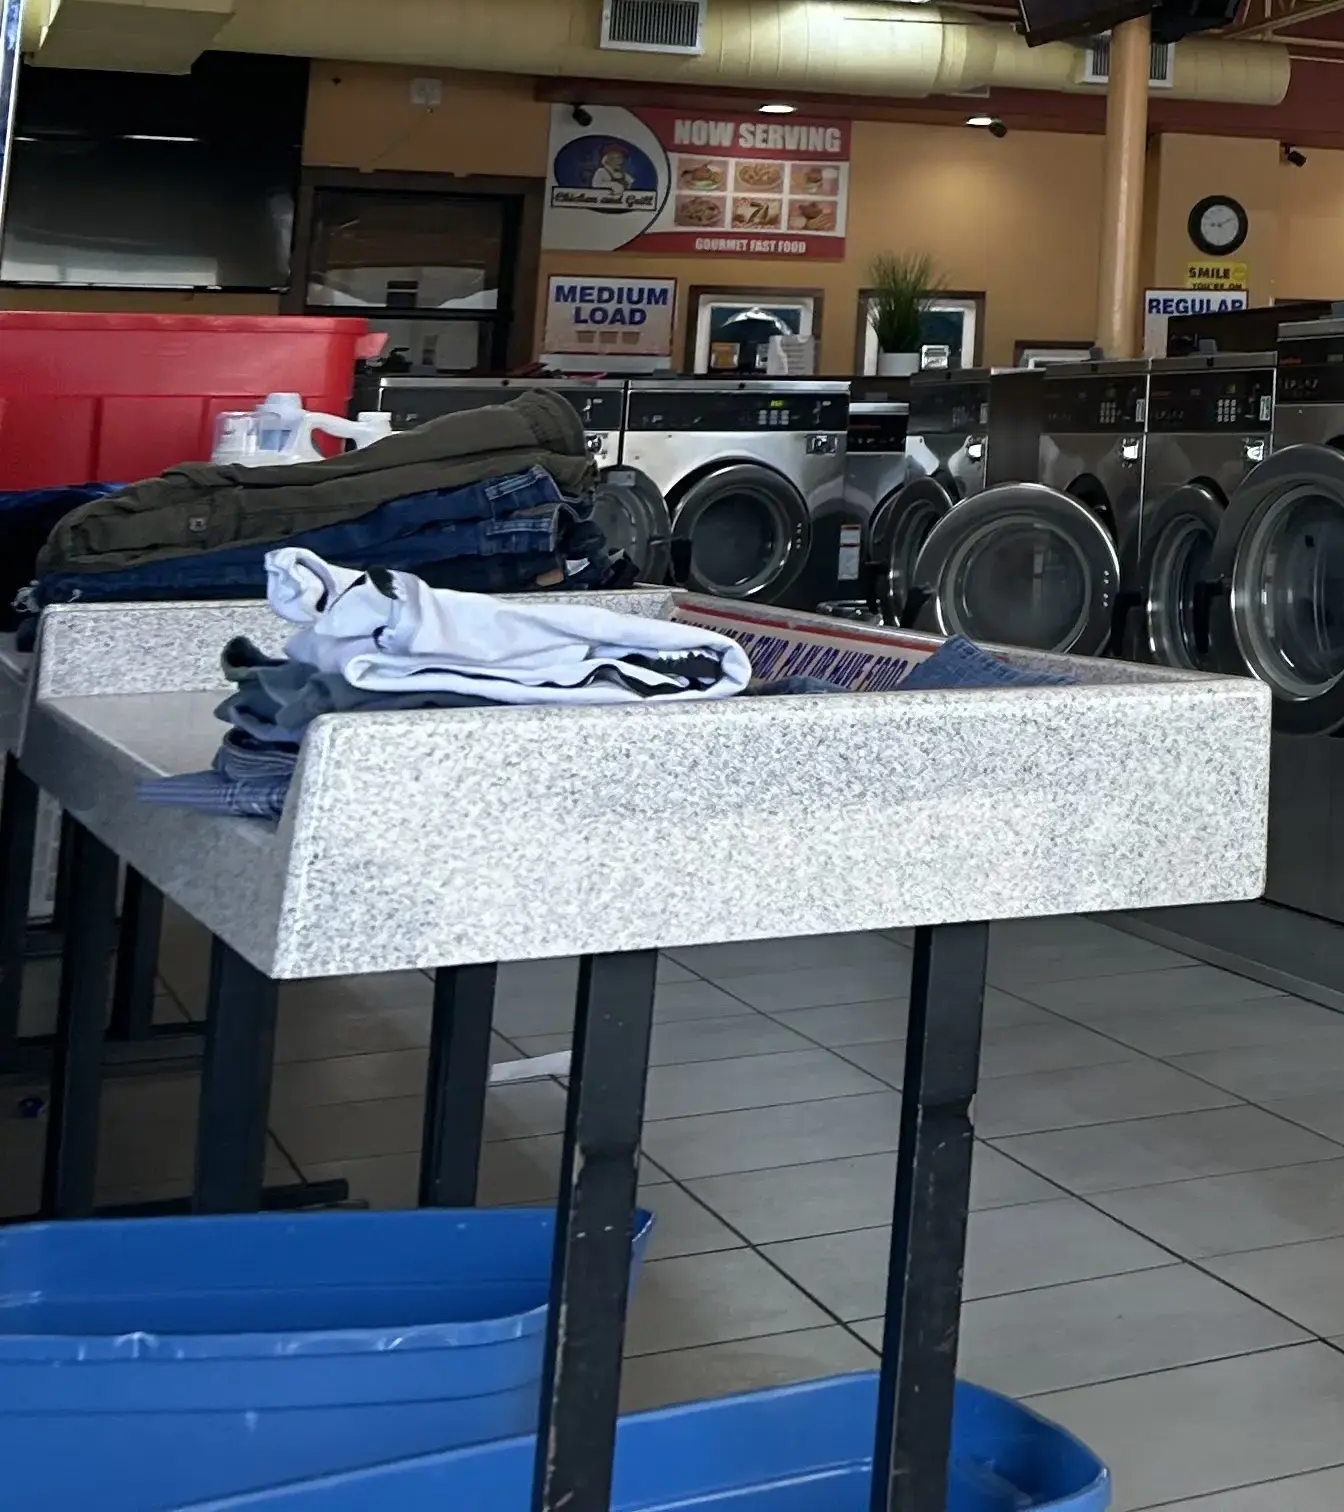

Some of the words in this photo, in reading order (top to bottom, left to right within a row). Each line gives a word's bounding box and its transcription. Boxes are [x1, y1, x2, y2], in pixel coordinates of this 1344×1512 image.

[674, 119, 735, 147] NOW
[738, 121, 841, 153] SERVING
[695, 238, 748, 252] GOURMET
[749, 239, 777, 253] FAST
[778, 240, 807, 254] FOOD
[1188, 267, 1231, 280] SMILE
[554, 284, 668, 306] MEDIUM
[573, 306, 648, 326] LOAD
[1148, 298, 1245, 315] REGULAR
[773, 642, 824, 681] PLAY
[808, 646, 840, 679] OR
[827, 649, 874, 688] HAVE
[856, 656, 909, 692] FOOD
